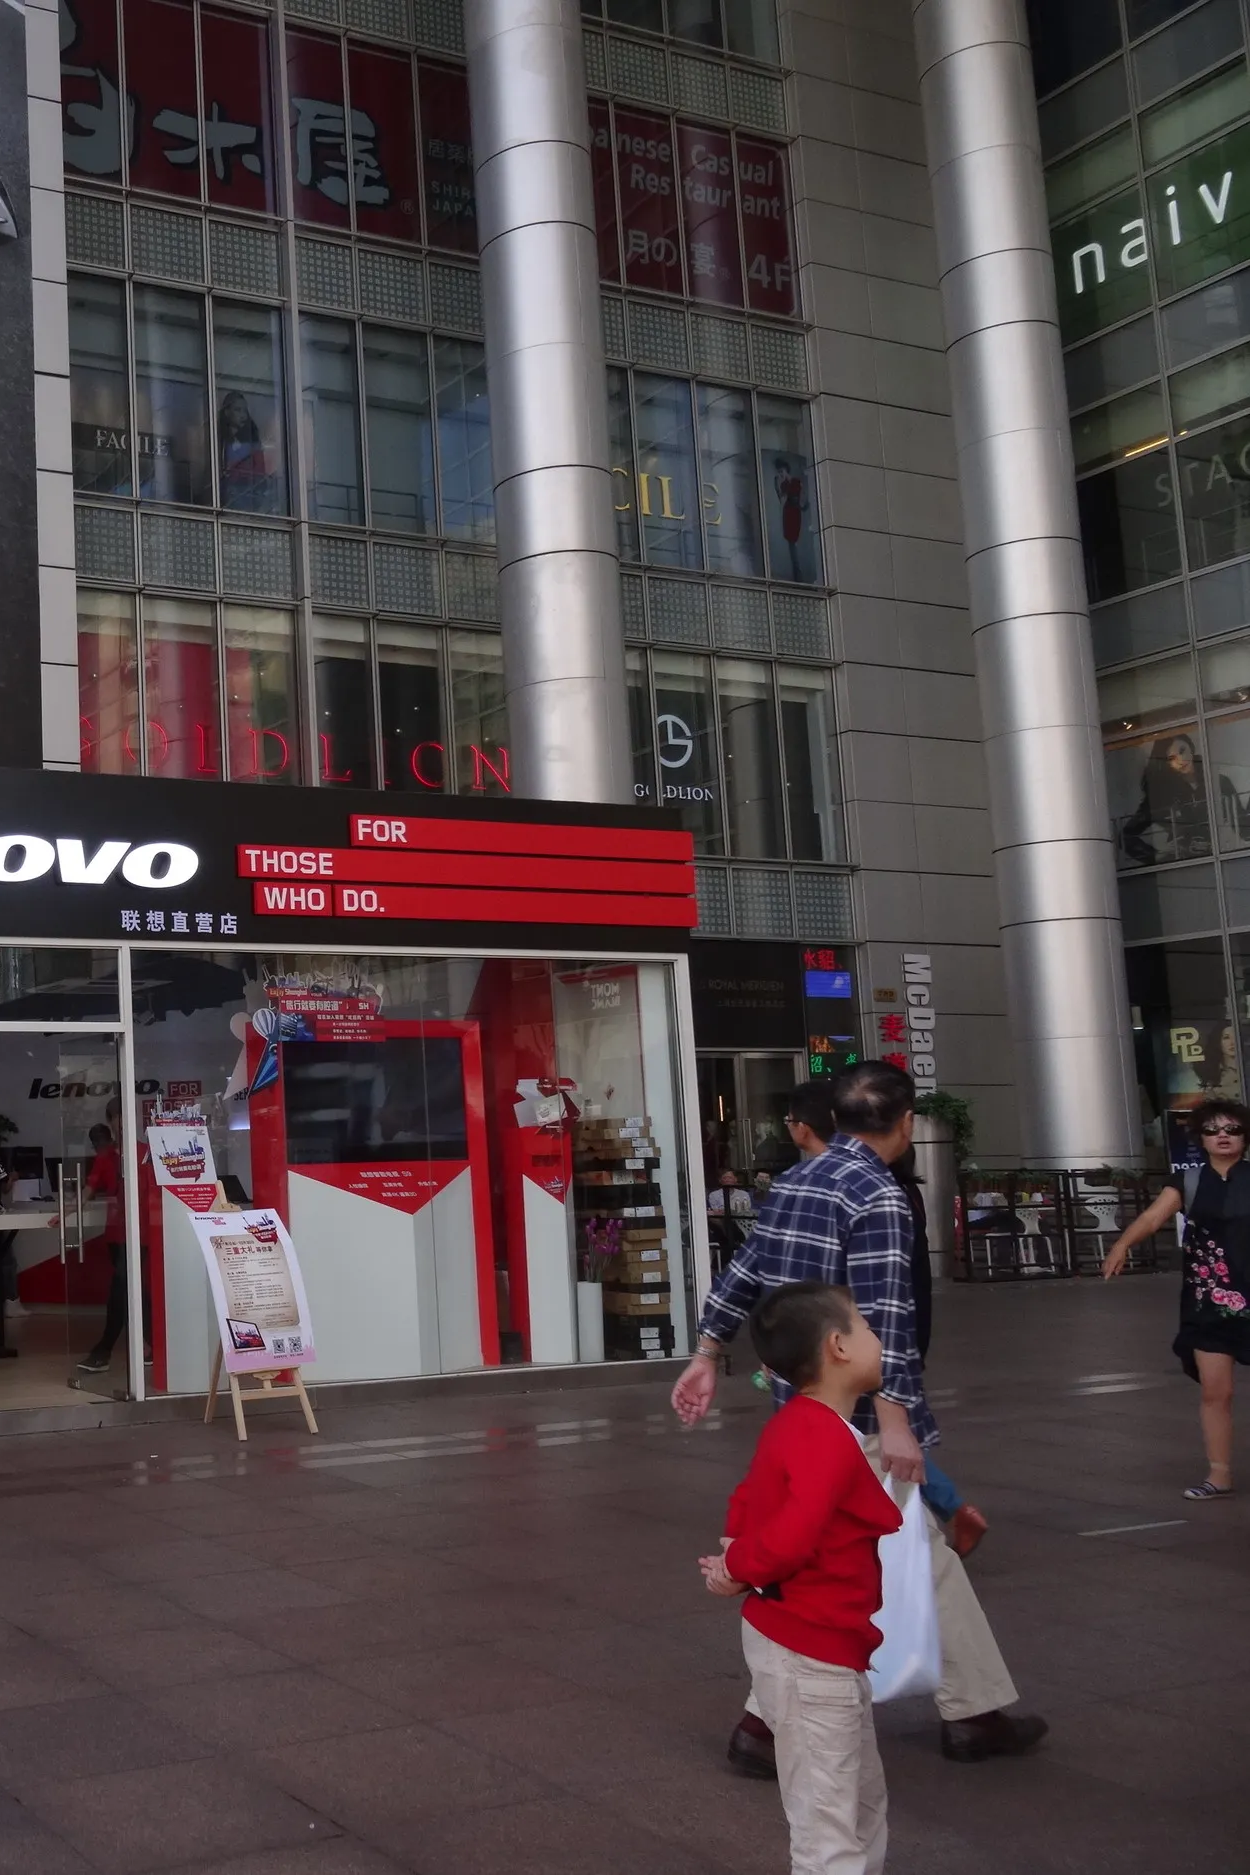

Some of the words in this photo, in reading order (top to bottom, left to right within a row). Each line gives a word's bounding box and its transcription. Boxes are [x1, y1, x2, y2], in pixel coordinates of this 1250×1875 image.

[590, 125, 670, 161] anese
[691, 144, 773, 186] Casual
[631, 164, 780, 220] Restaurant
[1071, 171, 1232, 295] naiv
[357, 819, 406, 843] FOR
[245, 848, 333, 876] THOSE
[263, 886, 325, 912] WHO
[343, 889, 385, 913] DO.
[120, 909, 237, 936] 联想直营店
[169, 1083, 198, 1097] FOR
